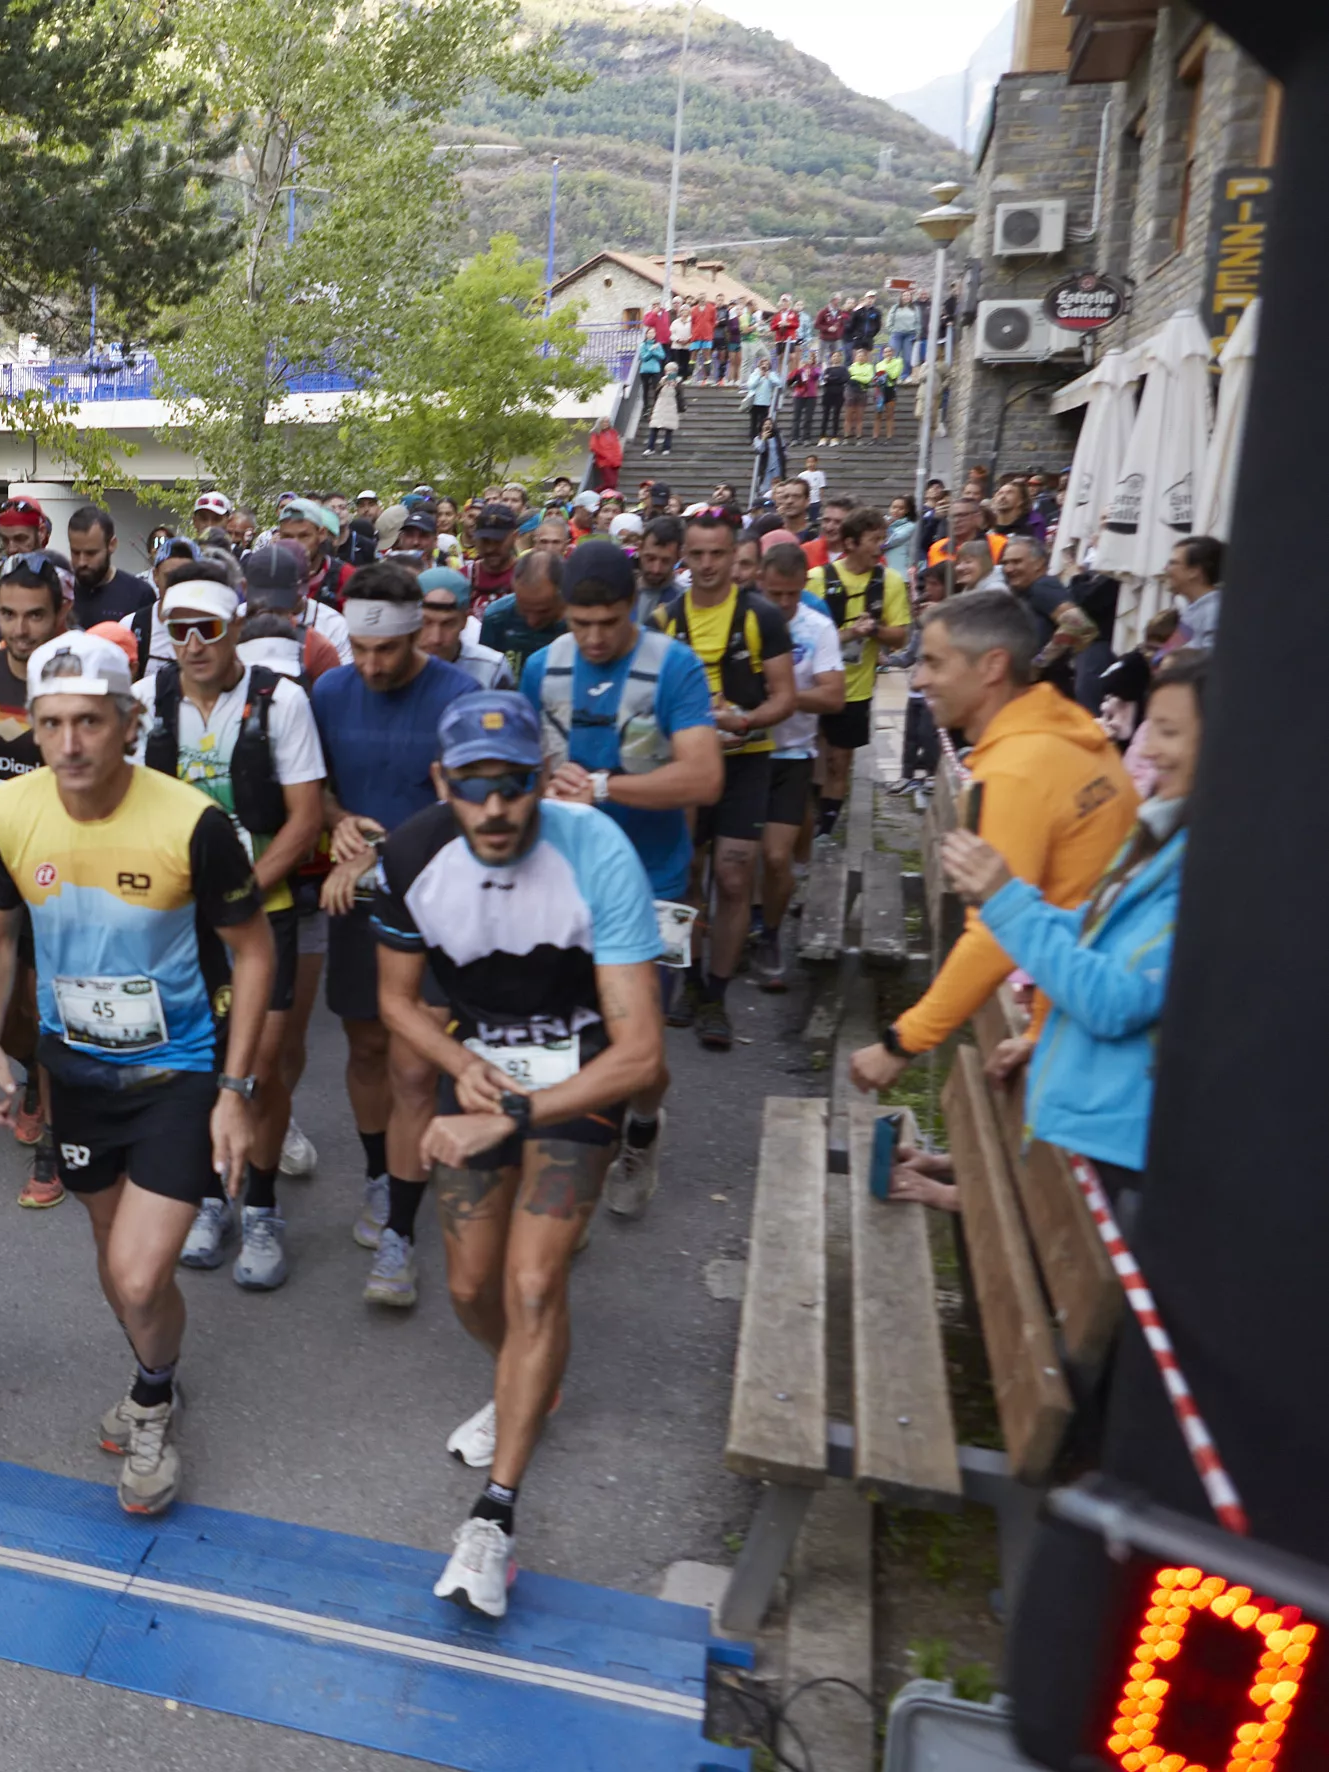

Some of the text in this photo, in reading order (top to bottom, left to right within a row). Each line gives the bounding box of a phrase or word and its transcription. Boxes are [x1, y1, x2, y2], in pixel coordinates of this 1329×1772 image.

[1056, 289, 1116, 304] Estrella
[1057, 304, 1112, 318] Galicia
[92, 1001, 115, 1018] 45
